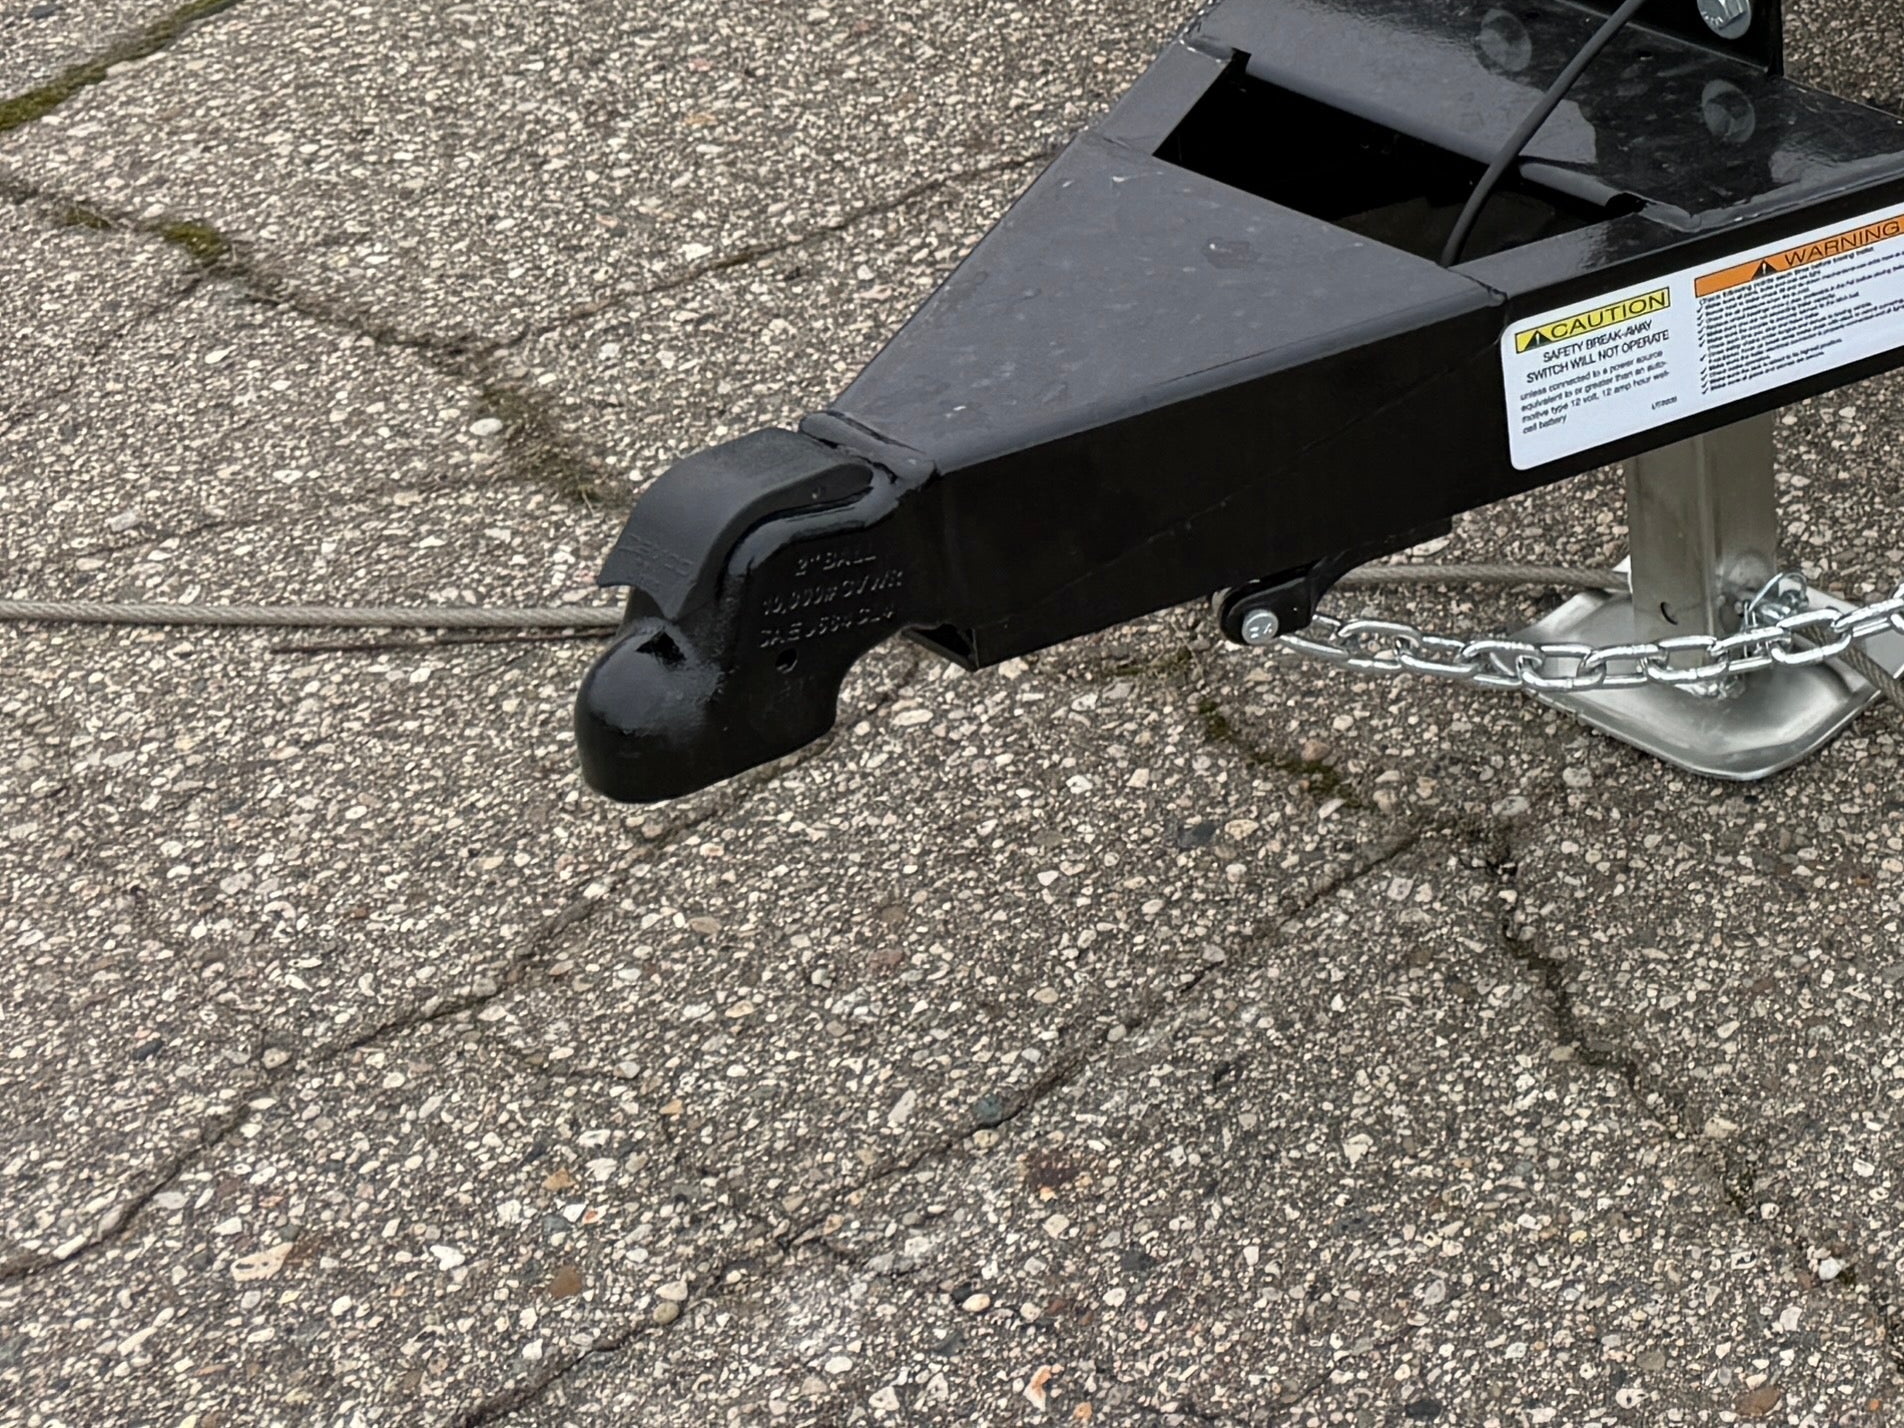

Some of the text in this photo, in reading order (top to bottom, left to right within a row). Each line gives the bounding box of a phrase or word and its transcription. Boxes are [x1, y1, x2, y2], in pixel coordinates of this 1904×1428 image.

[1784, 221, 1900, 266] WARNING
[1551, 291, 1666, 339] CAUTION
[1526, 329, 1670, 384] SWITCH WILL NOT OPERATE
[1543, 320, 1652, 363] SAFETY BREAK-AWAY
[1520, 386, 1547, 401] unless
[1548, 373, 1591, 396] connected
[1609, 358, 1634, 374] power
[1521, 393, 1563, 413] equivalent
[1584, 376, 1613, 396] greater
[1615, 369, 1635, 383] than
[1522, 408, 1549, 423] motive
[1551, 403, 1569, 417] type
[1571, 399, 1581, 408] 12
[1602, 389, 1612, 397] 12
[1614, 383, 1631, 397] amp
[1633, 375, 1651, 388] hour
[1522, 414, 1567, 434] cell battery
